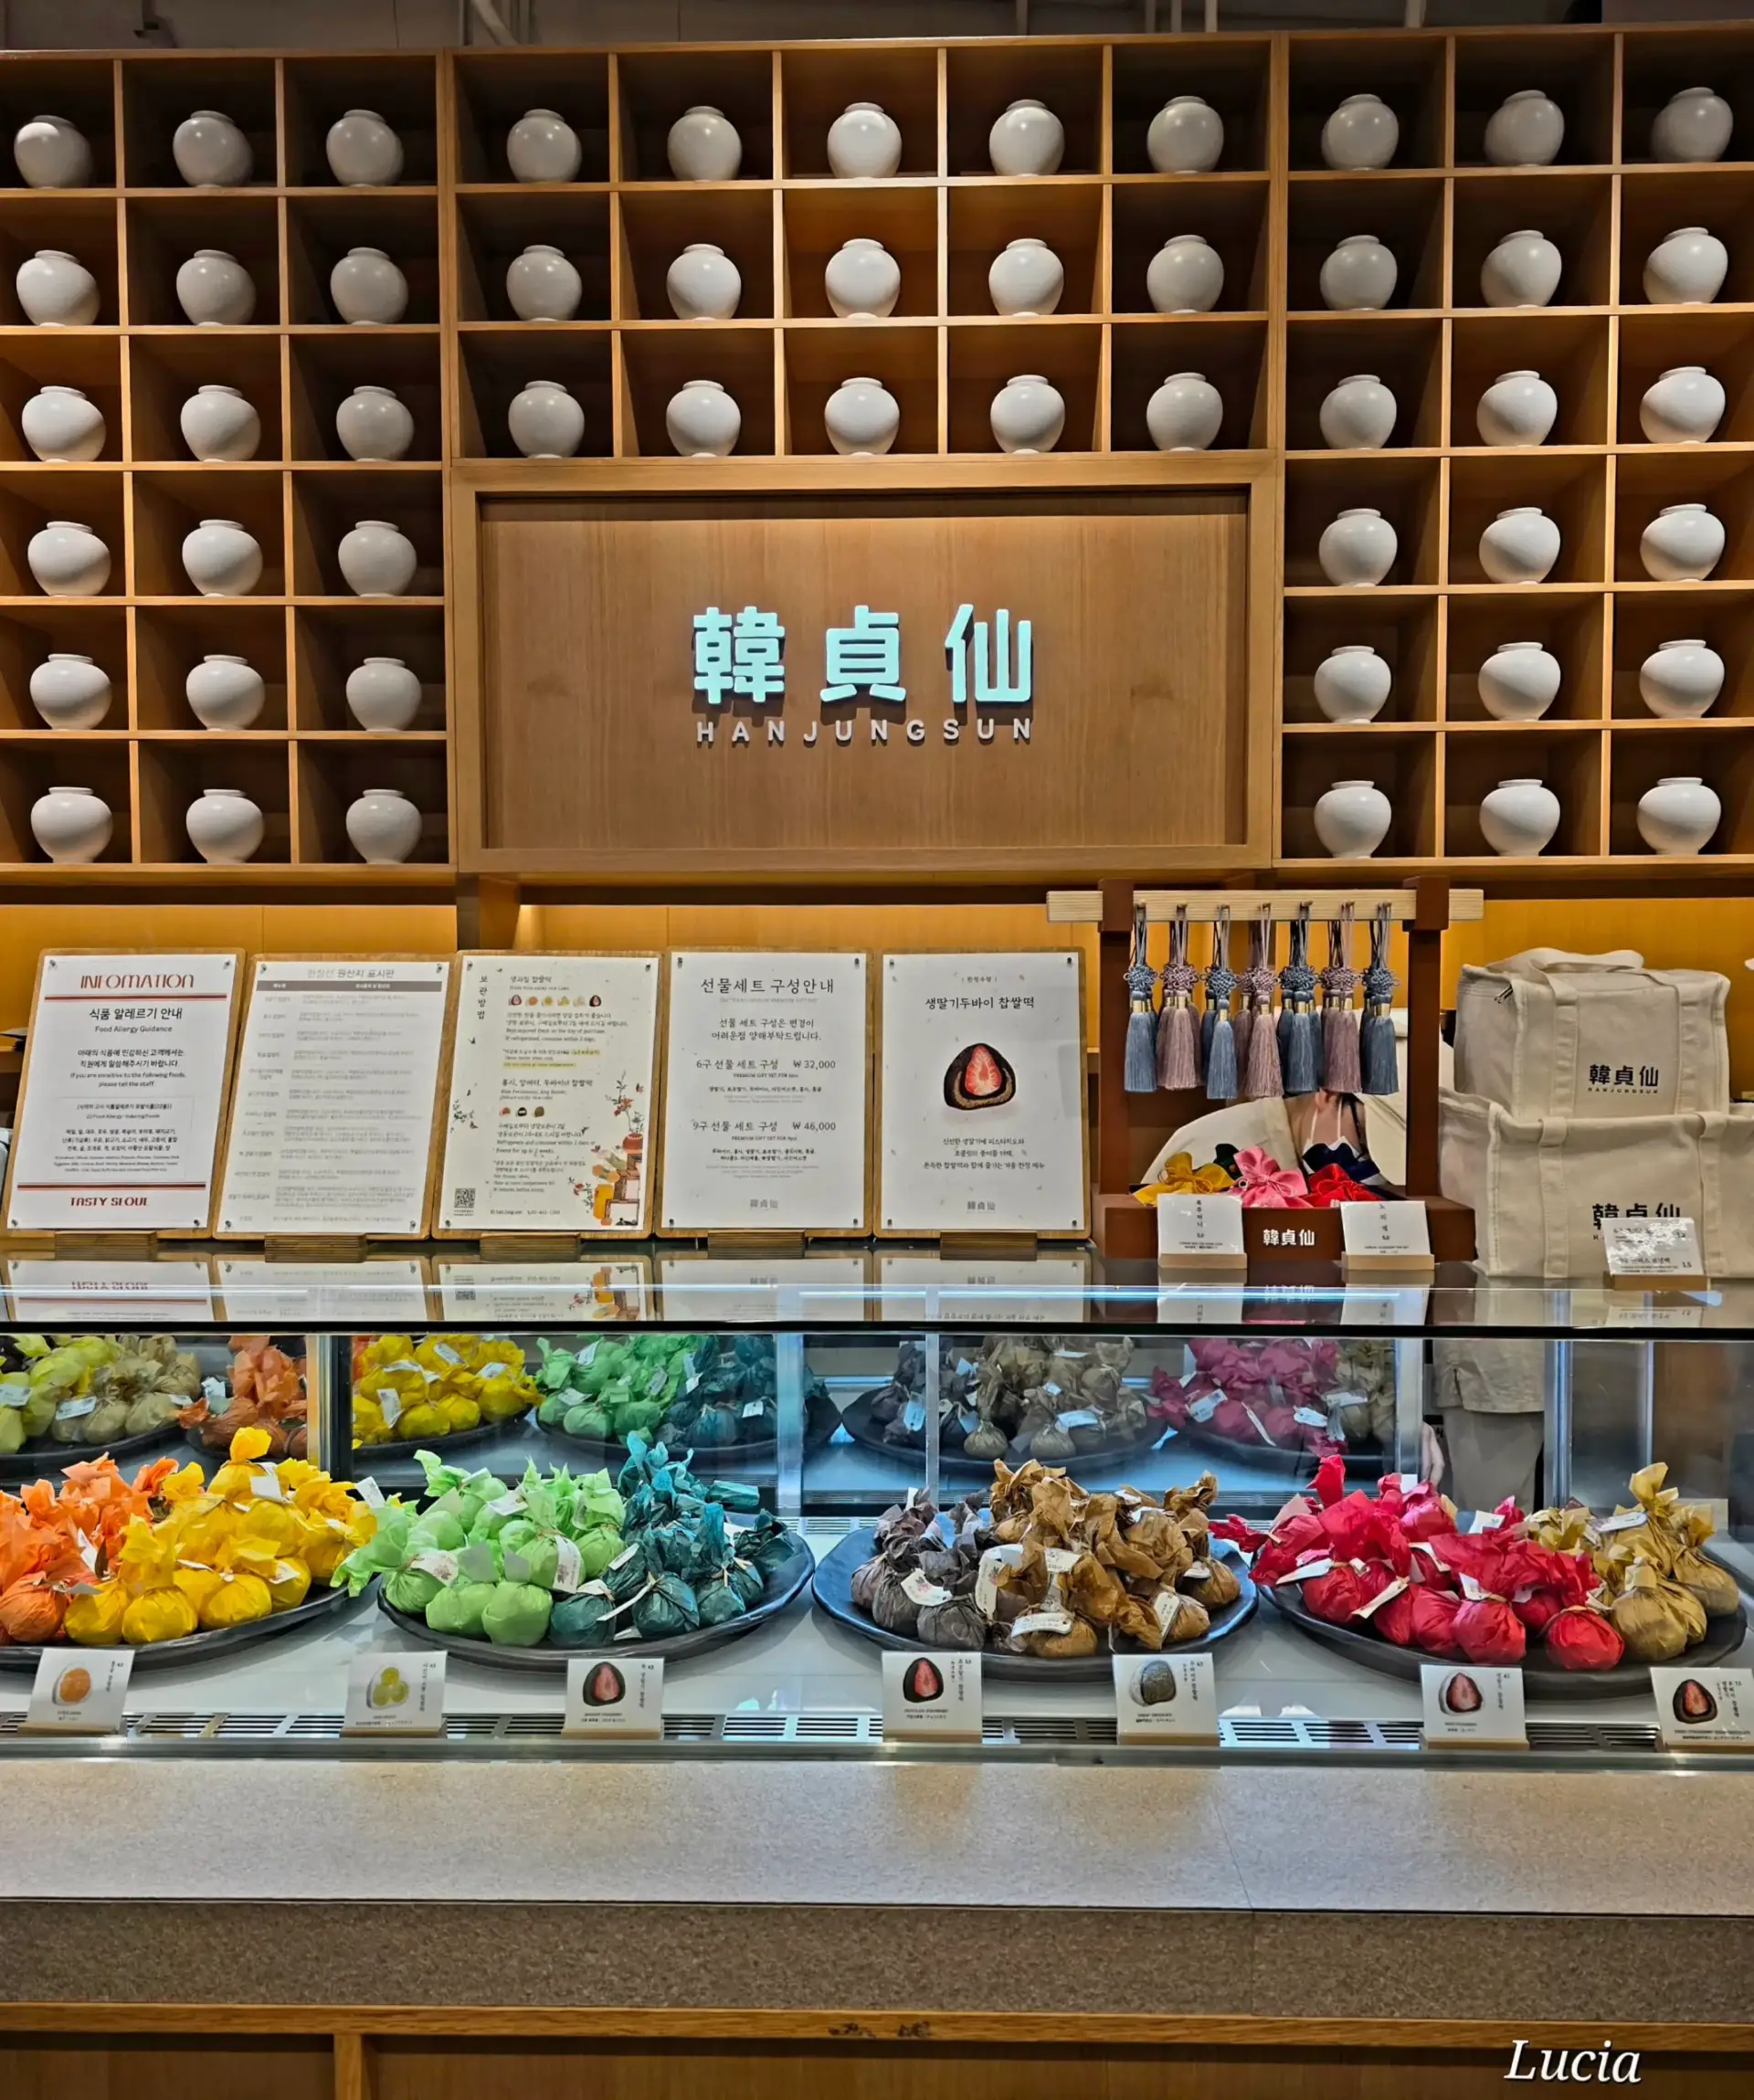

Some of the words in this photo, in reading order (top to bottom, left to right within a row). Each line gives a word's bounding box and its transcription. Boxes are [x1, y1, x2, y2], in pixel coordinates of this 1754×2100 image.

[693, 604, 1031, 704] 韓貞仙
[696, 718, 1031, 743] HANJUNGSUN
[337, 968, 364, 978] 원산지
[367, 968, 395, 978] 표시판
[701, 977, 766, 994] 선물세트
[770, 977, 834, 994] 구성안내
[925, 997, 994, 1010] 생딸기두바이
[999, 997, 1035, 1010] 찹쌀떡
[89, 1008, 111, 1020] 식품
[114, 1008, 157, 1020] 알레르기
[160, 1008, 183, 1020] 안내
[95, 1025, 112, 1033] Food
[113, 1025, 138, 1033] Allergy
[140, 1025, 173, 1033] Guidance
[720, 1018, 736, 1029] 선물
[739, 1018, 757, 1029] 세트
[760, 1018, 787, 1029] 구성은
[789, 1018, 814, 1029] 변경이
[712, 1031, 746, 1041] 어려운점
[749, 1031, 822, 1041] 양해부탁드립니다.
[696, 1060, 712, 1070] 6구
[714, 1060, 734, 1070] 선물
[736, 1060, 756, 1070] 세트
[759, 1060, 778, 1070] 구성
[804, 1060, 836, 1070] 32,000
[1589, 1064, 1659, 1087] 韓貞仙
[692, 1121, 708, 1132] 9구
[711, 1121, 731, 1132] 선물
[734, 1121, 755, 1132] 세트
[758, 1121, 777, 1132] 구성
[804, 1121, 836, 1132] 46,000
[70, 1197, 108, 1207] TASTY
[1263, 1229, 1316, 1246] 韓貞仙
